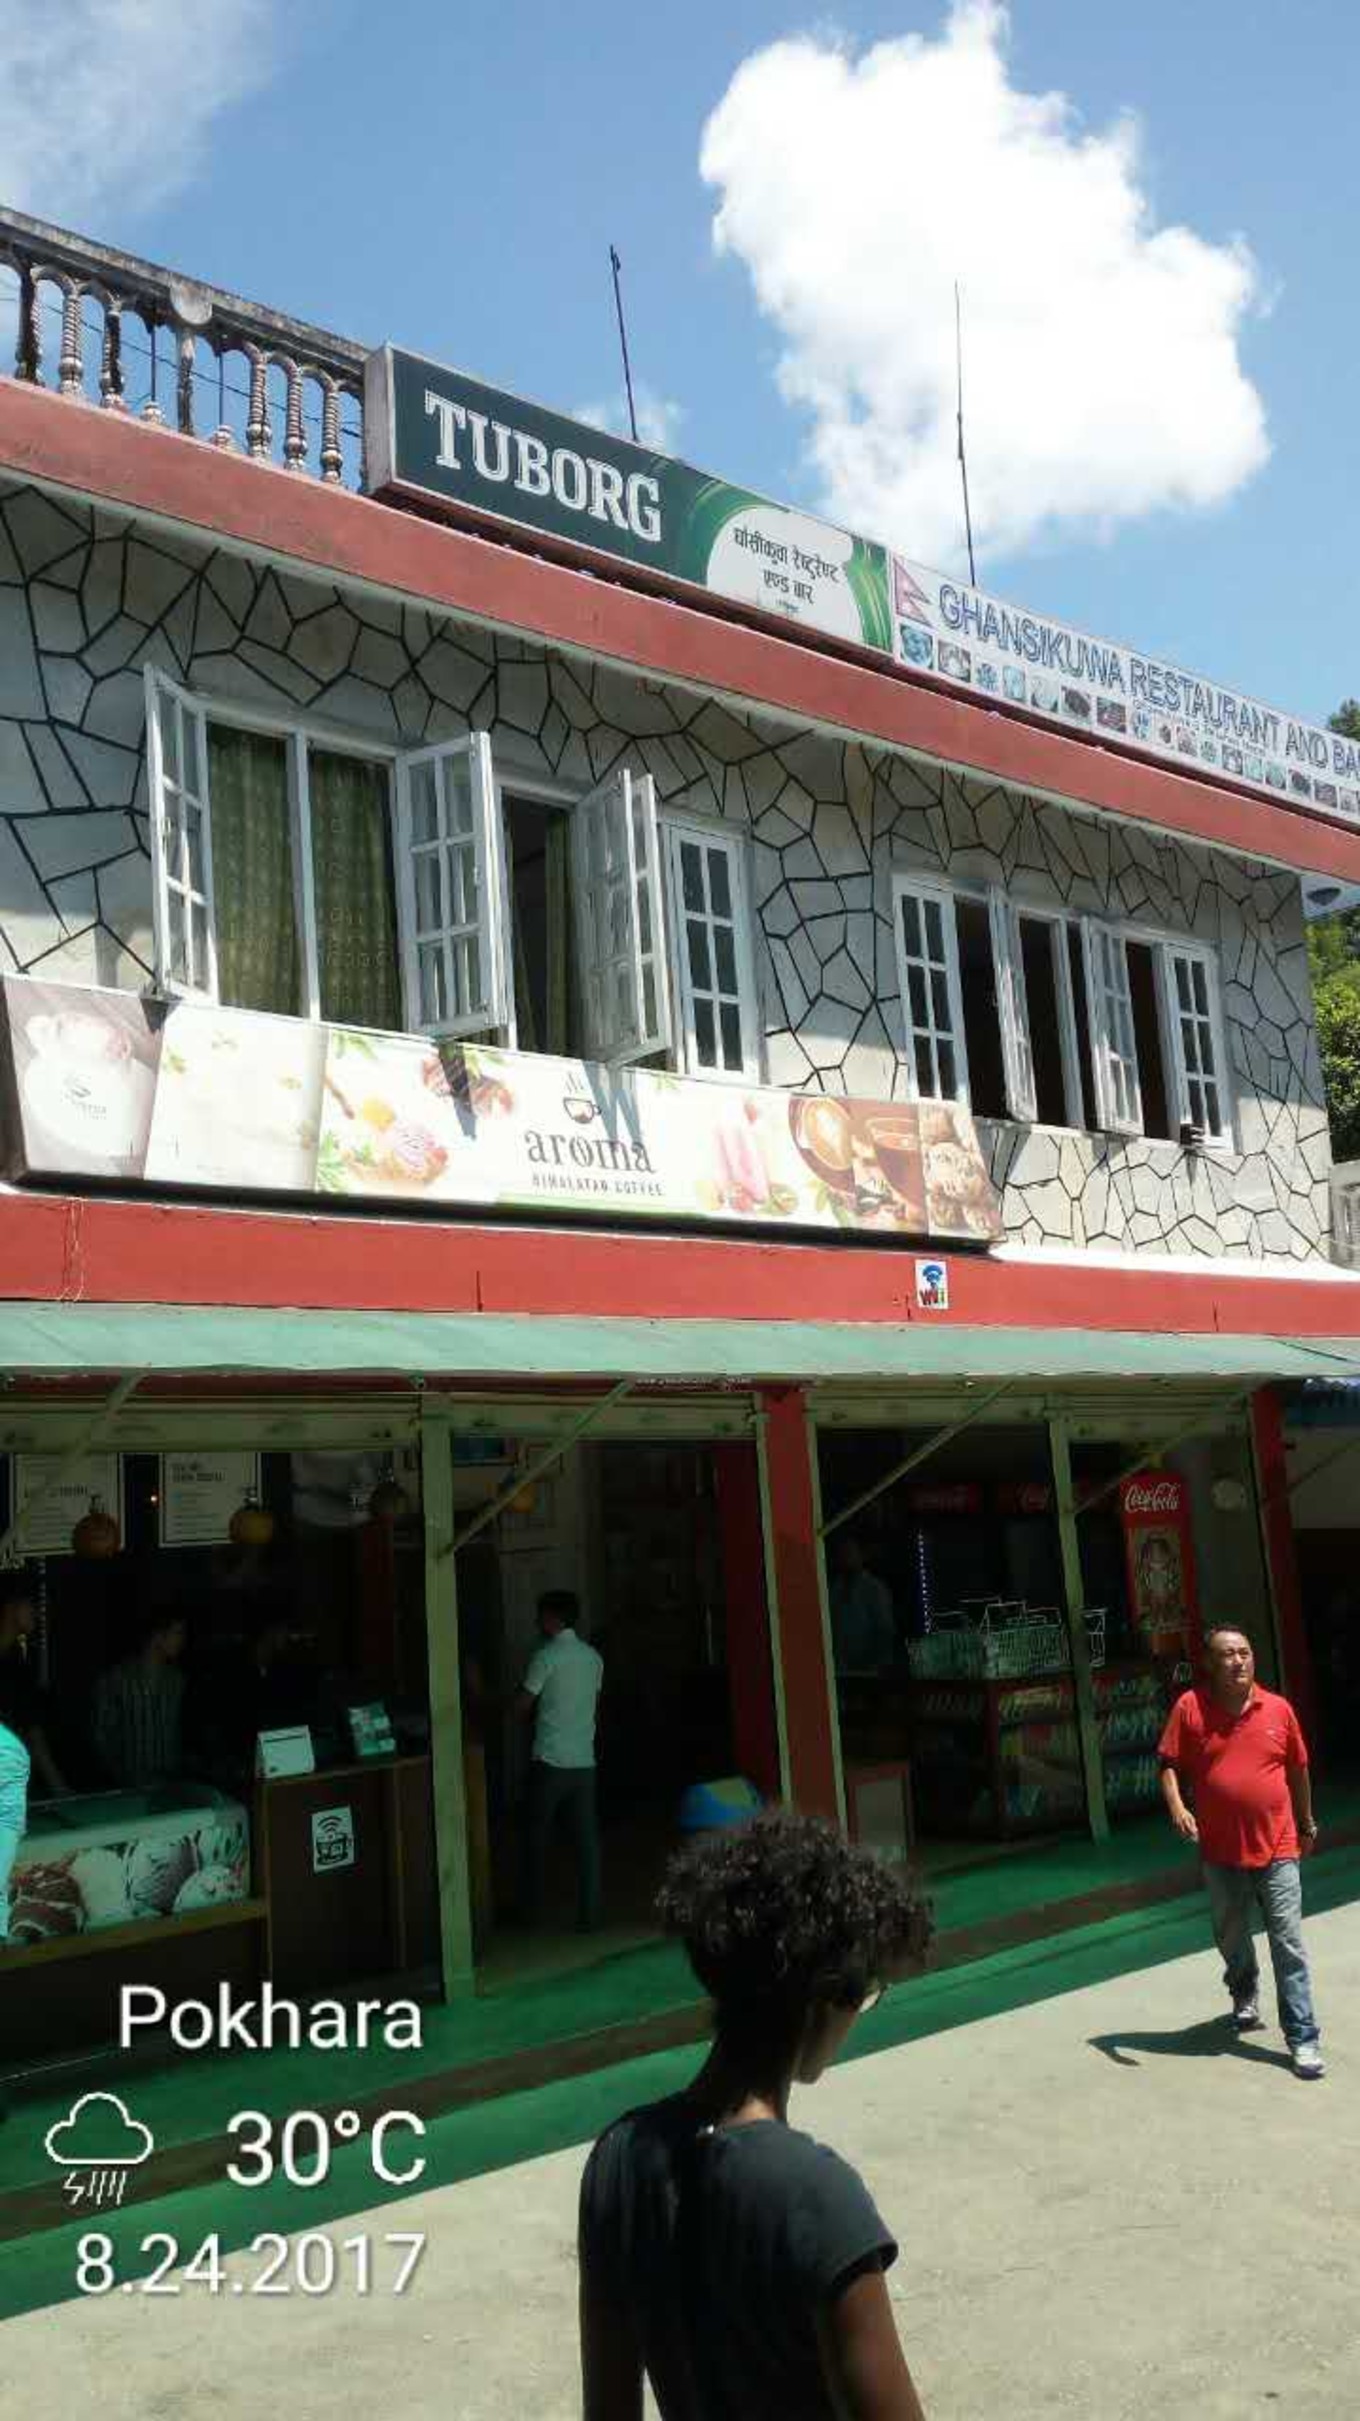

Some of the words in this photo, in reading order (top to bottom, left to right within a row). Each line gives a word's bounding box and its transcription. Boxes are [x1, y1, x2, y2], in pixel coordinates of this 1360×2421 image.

[425, 389, 661, 542] TUBORG
[939, 584, 1125, 692] GHANSIKUWA
[1130, 657, 1279, 753] RESTAURANT
[1285, 722, 1329, 768] AND
[524, 1130, 656, 1174] aroma
[532, 1172, 609, 1194] HIMALAYAN
[614, 1180, 664, 1197] COFFEE
